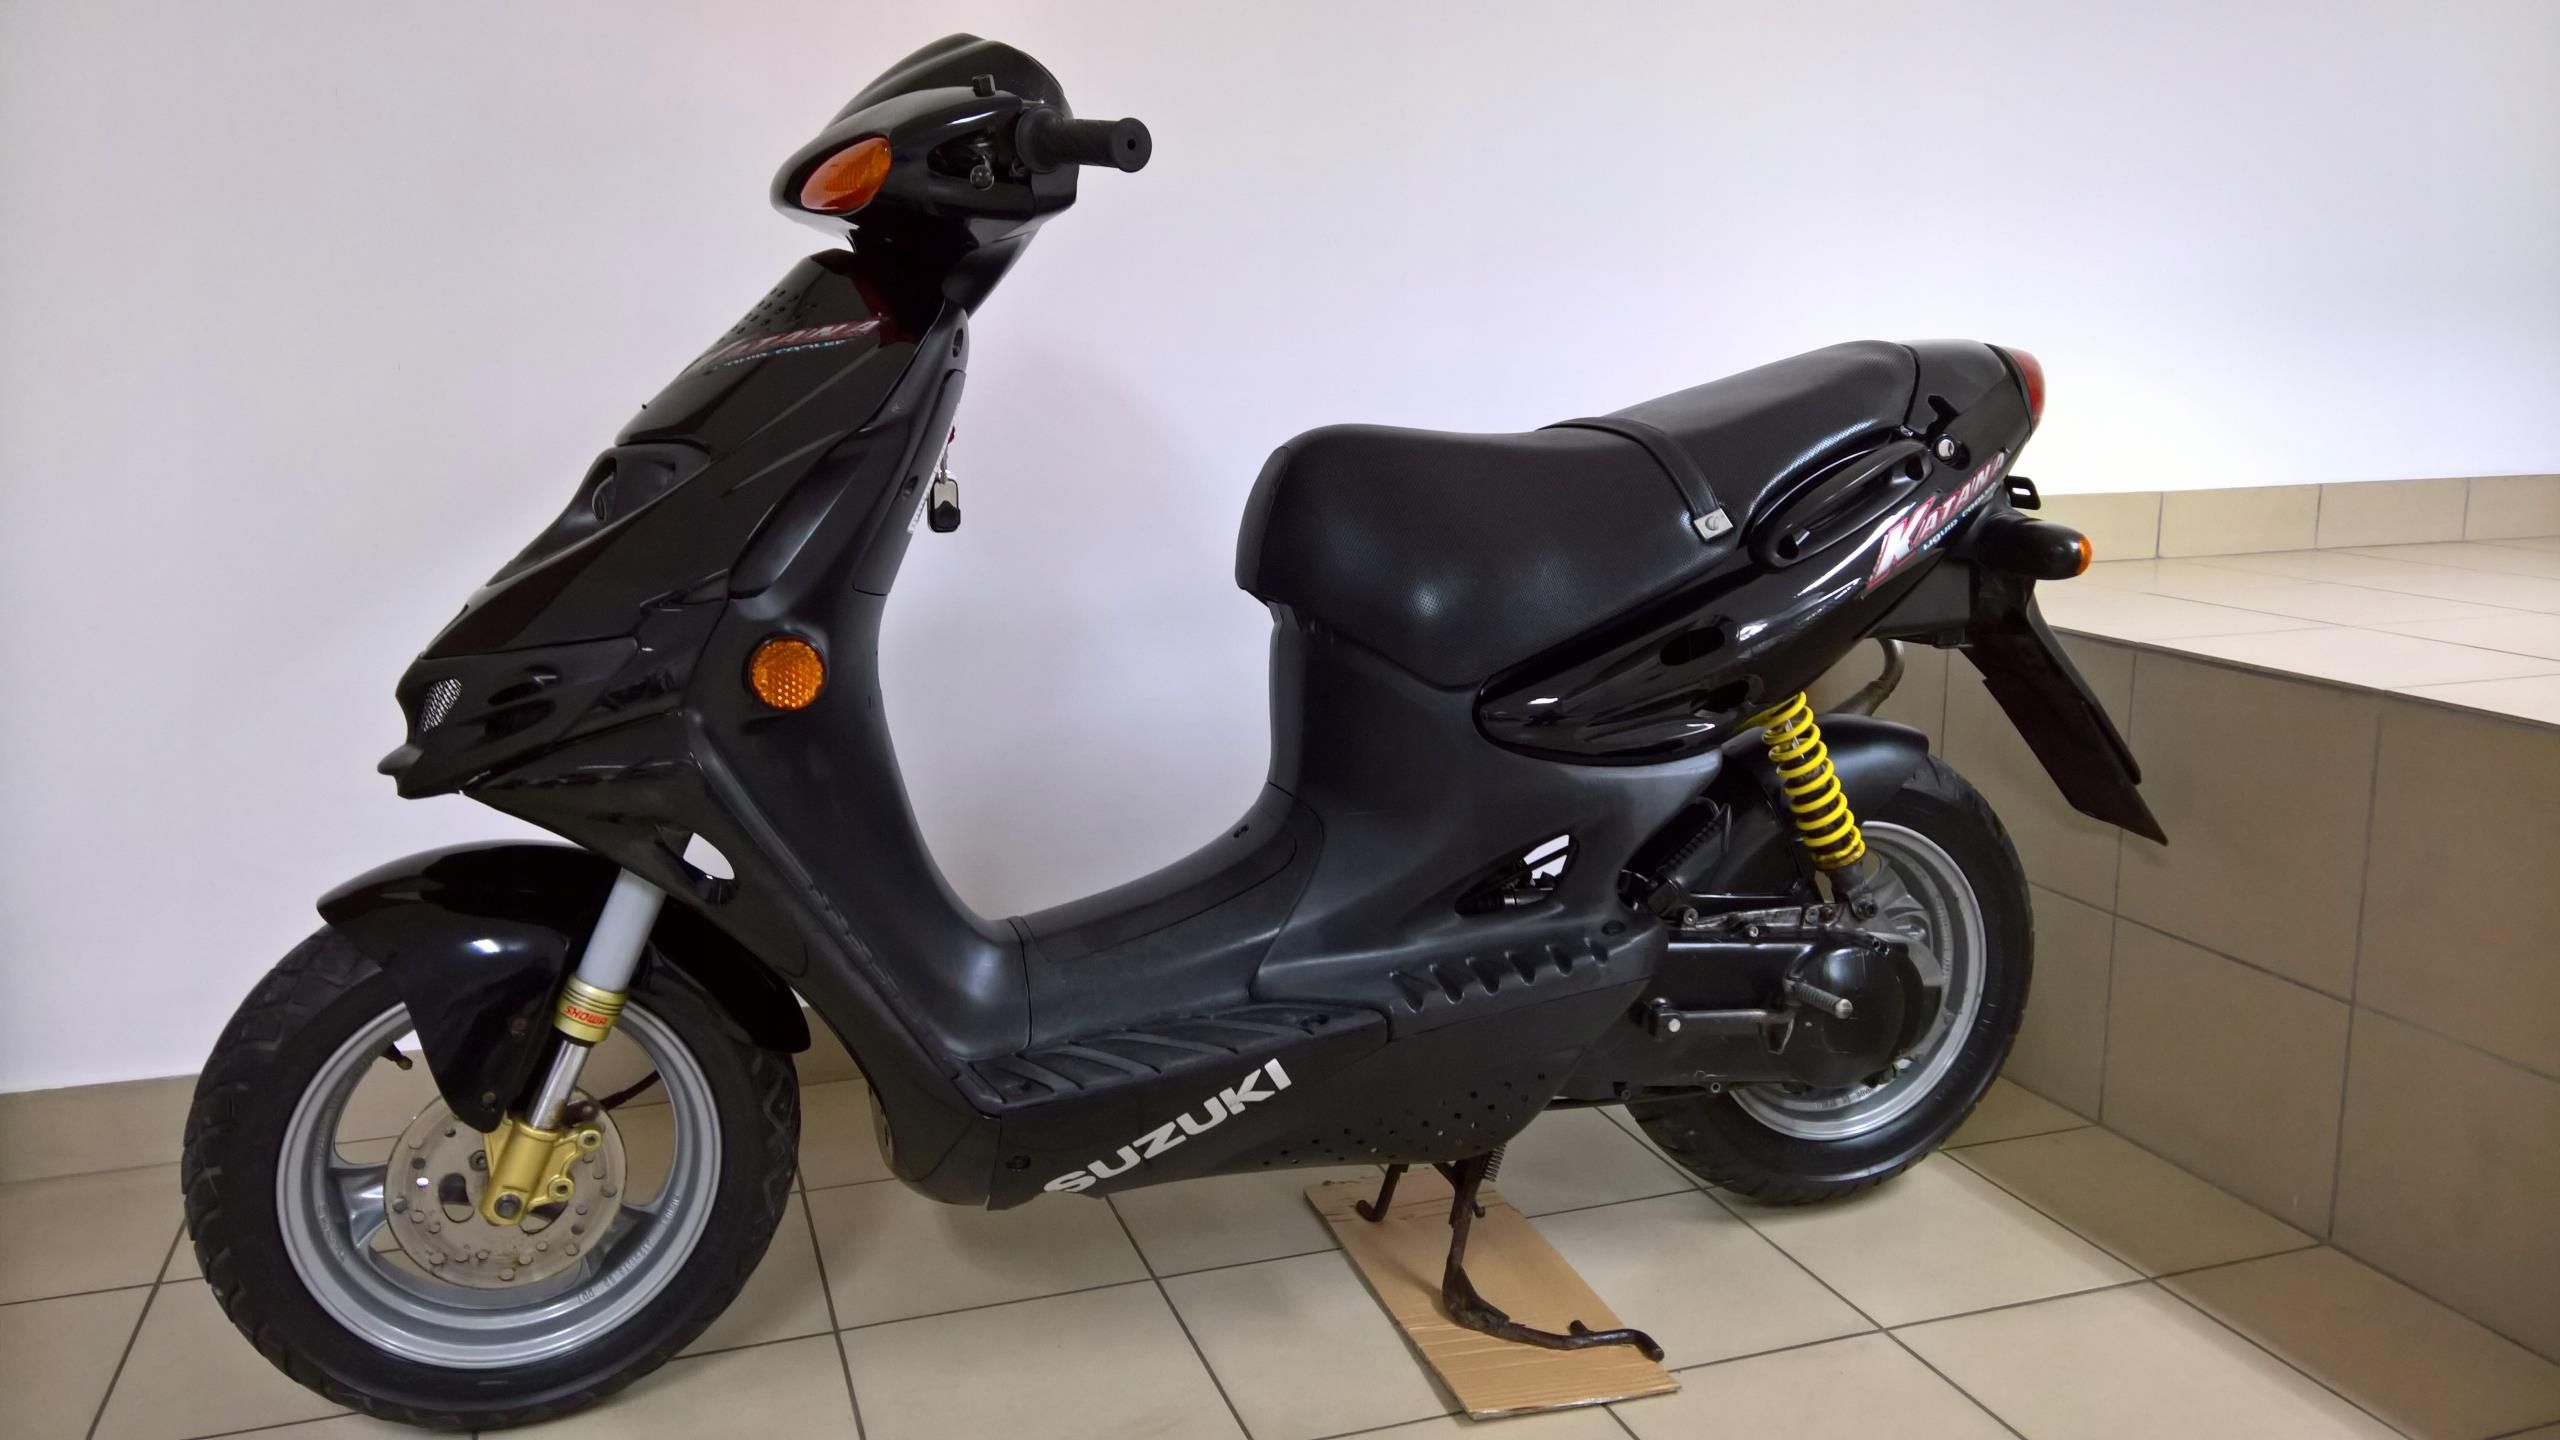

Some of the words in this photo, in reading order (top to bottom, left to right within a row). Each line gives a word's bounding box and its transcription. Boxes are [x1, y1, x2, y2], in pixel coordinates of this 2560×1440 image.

[1866, 451, 2008, 589] KATANA
[1923, 518, 1958, 551] LIQUID
[564, 1004, 609, 1026] SHOWA
[1043, 1057, 1292, 1193] SUZUKI
